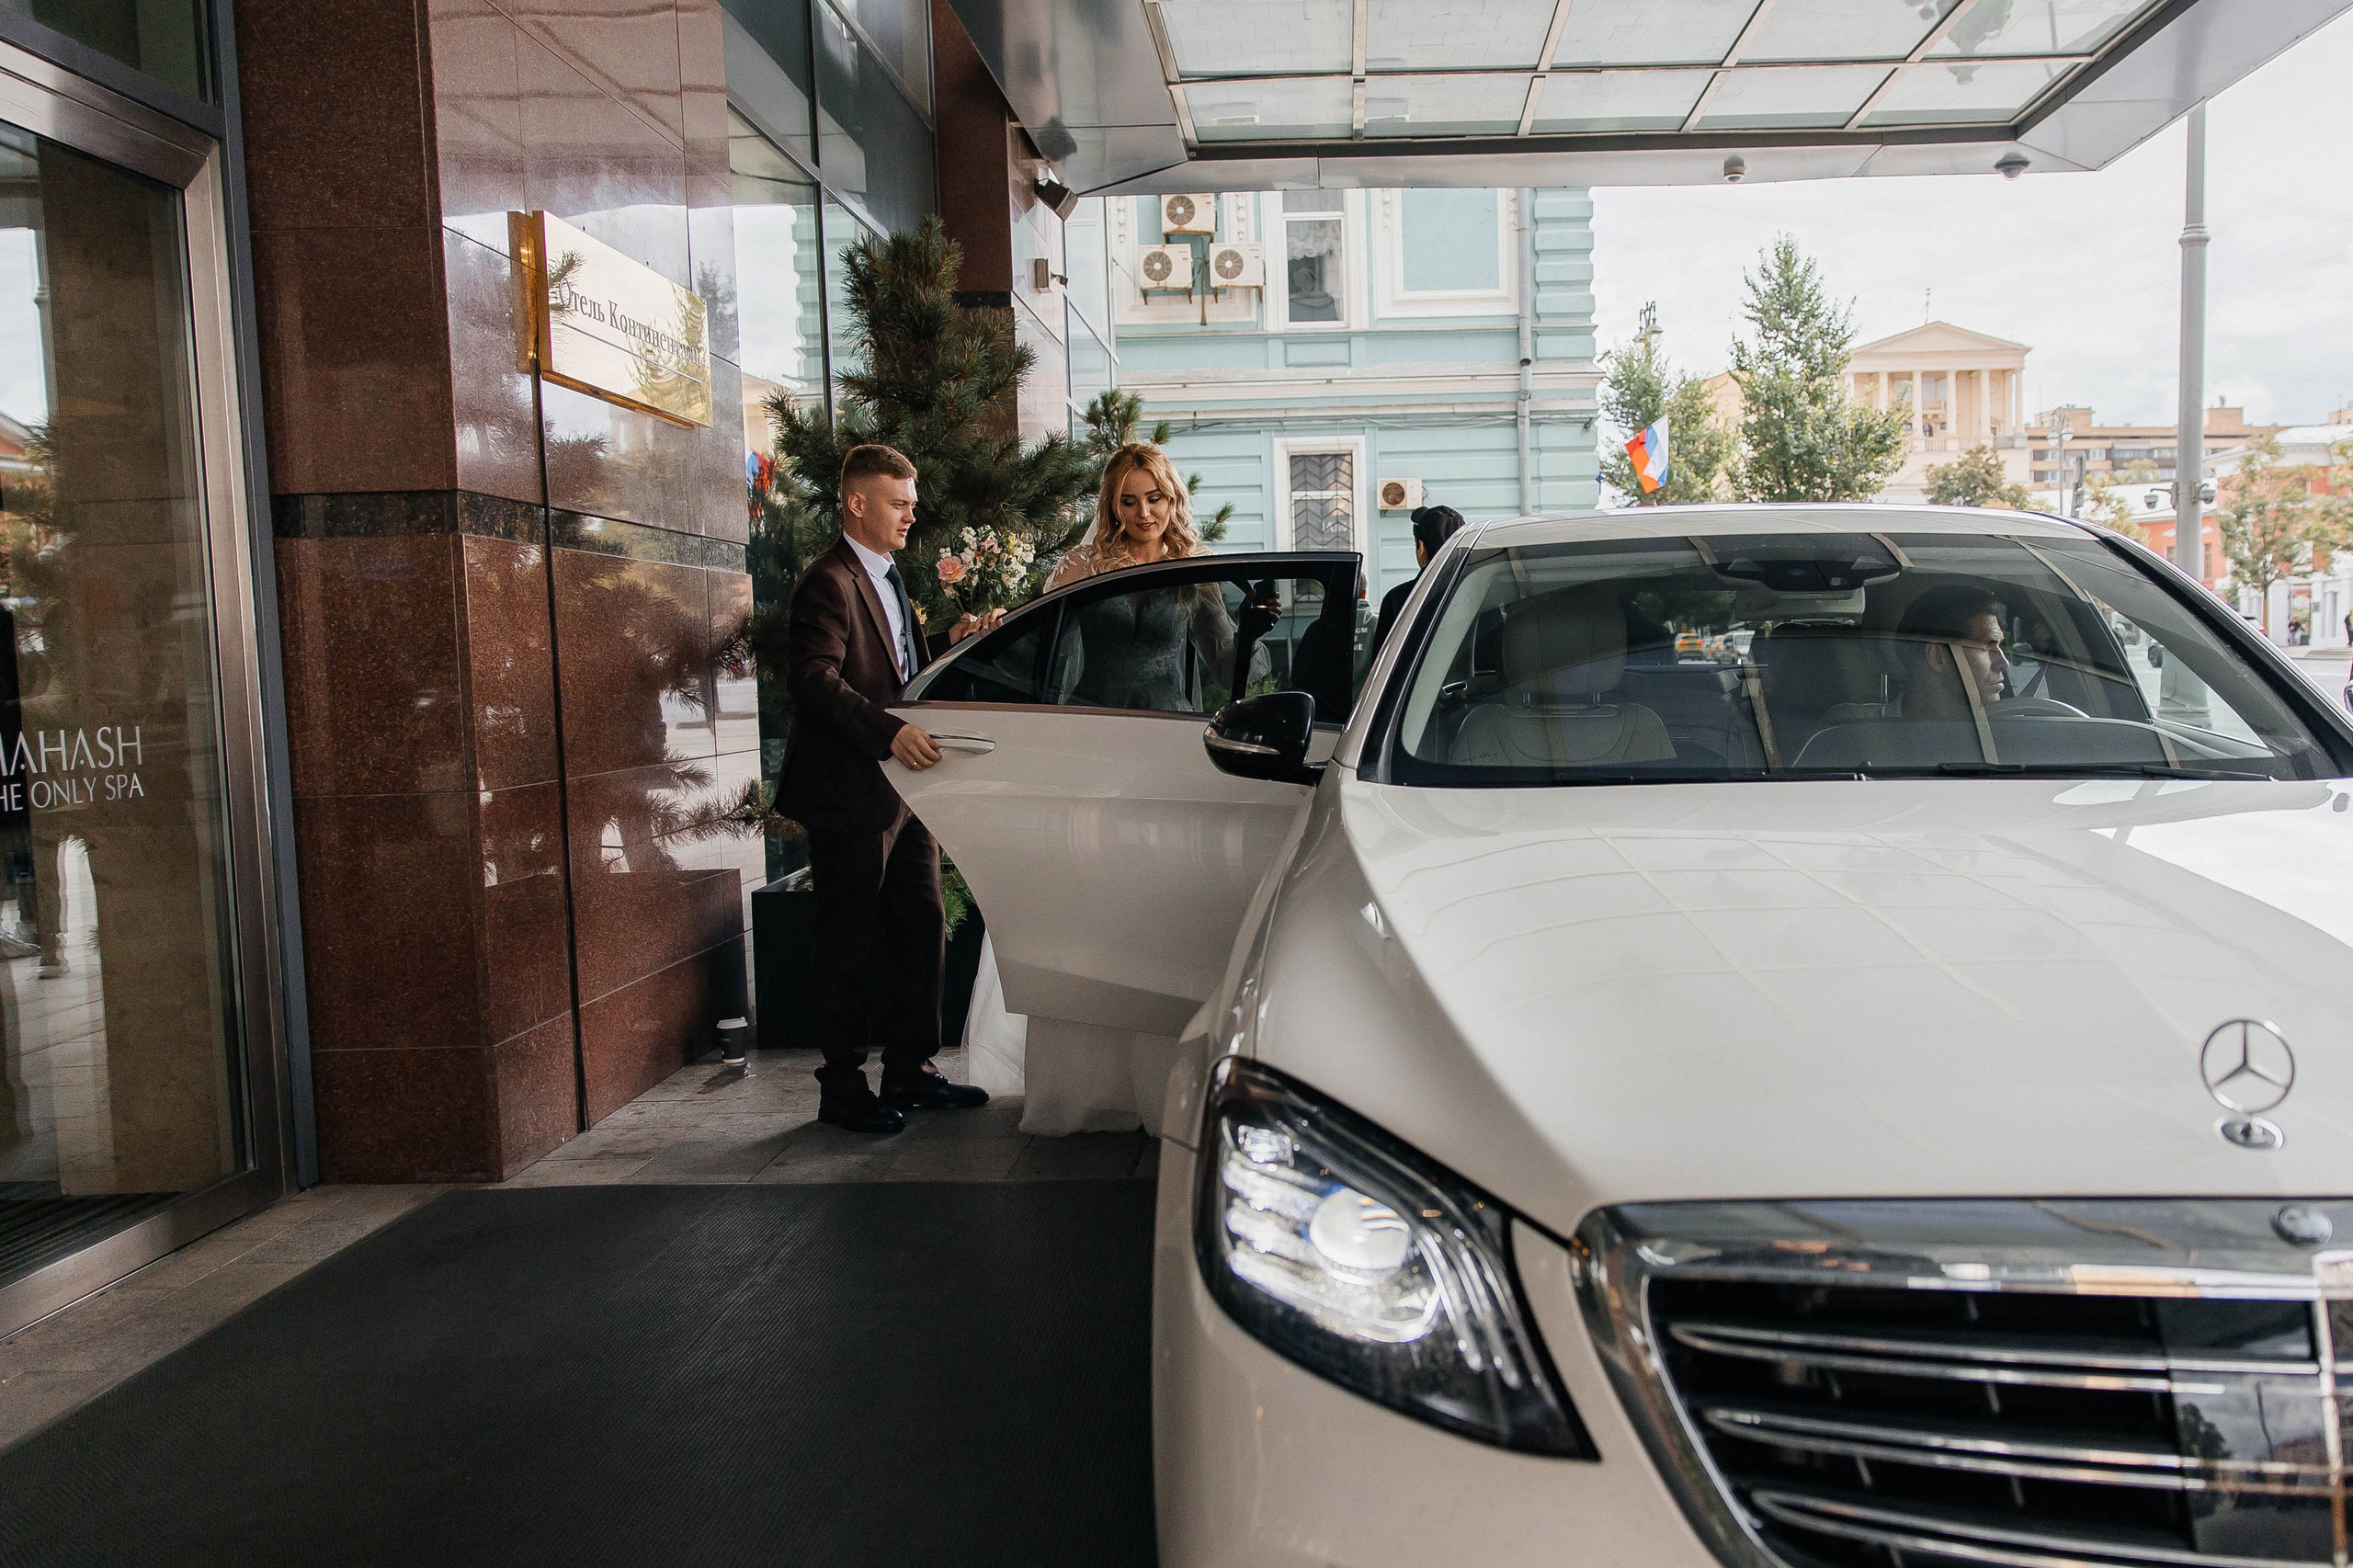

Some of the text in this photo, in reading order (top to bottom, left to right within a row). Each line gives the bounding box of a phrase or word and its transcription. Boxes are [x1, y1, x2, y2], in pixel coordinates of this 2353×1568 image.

[559, 278, 605, 323] Отель
[0, 726, 142, 777] AHASH
[30, 777, 97, 808] ONLY
[105, 772, 144, 801] SPA
